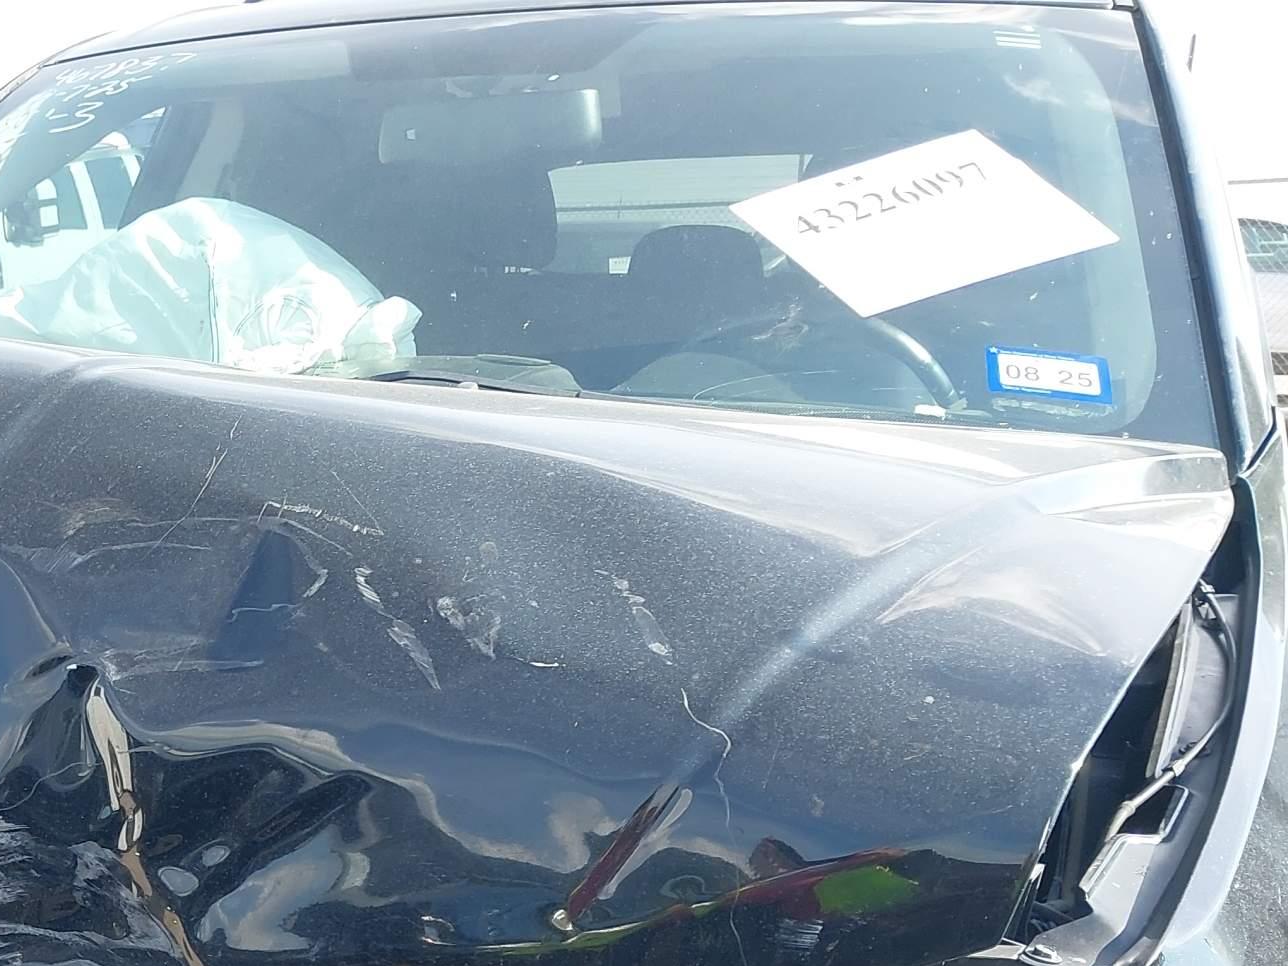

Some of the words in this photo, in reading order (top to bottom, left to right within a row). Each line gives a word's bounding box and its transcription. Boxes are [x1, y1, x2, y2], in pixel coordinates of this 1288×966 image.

[798, 162, 987, 234] 43226097
[1005, 364, 1040, 382] 08
[1058, 370, 1093, 387] 25
